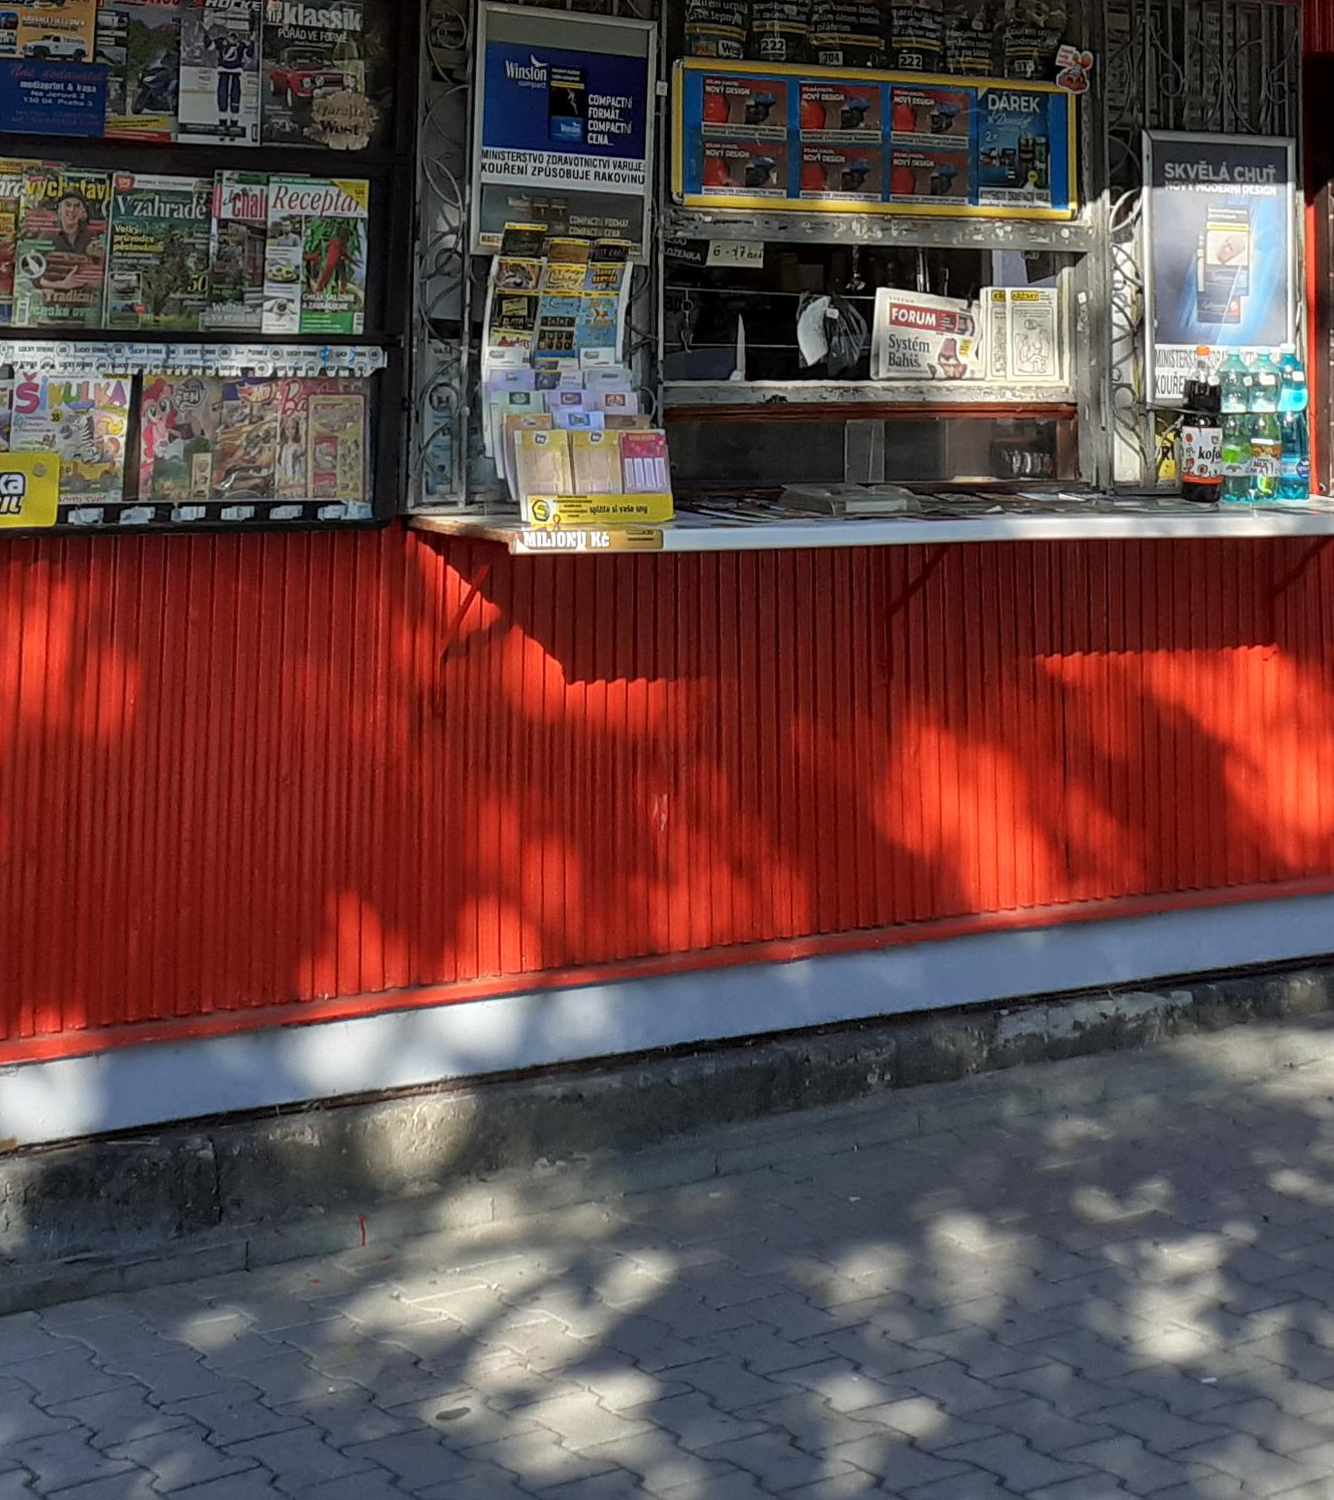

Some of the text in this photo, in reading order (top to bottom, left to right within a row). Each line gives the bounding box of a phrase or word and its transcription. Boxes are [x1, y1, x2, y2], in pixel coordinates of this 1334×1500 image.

[899, 55, 922, 67] 222
[987, 90, 1041, 113] DÁREK
[480, 149, 544, 165] MINISTERSTVO
[480, 161, 645, 185] KOUŘENÍ ZPŮSOBUJE RAKOVINU
[1164, 160, 1277, 183] SKVĚLÁ CHUŤ
[890, 305, 937, 327] FORUM
[888, 334, 931, 354] Systém
[1155, 372, 1185, 394] KOUŘE
[591, 531, 610, 548] Kč
